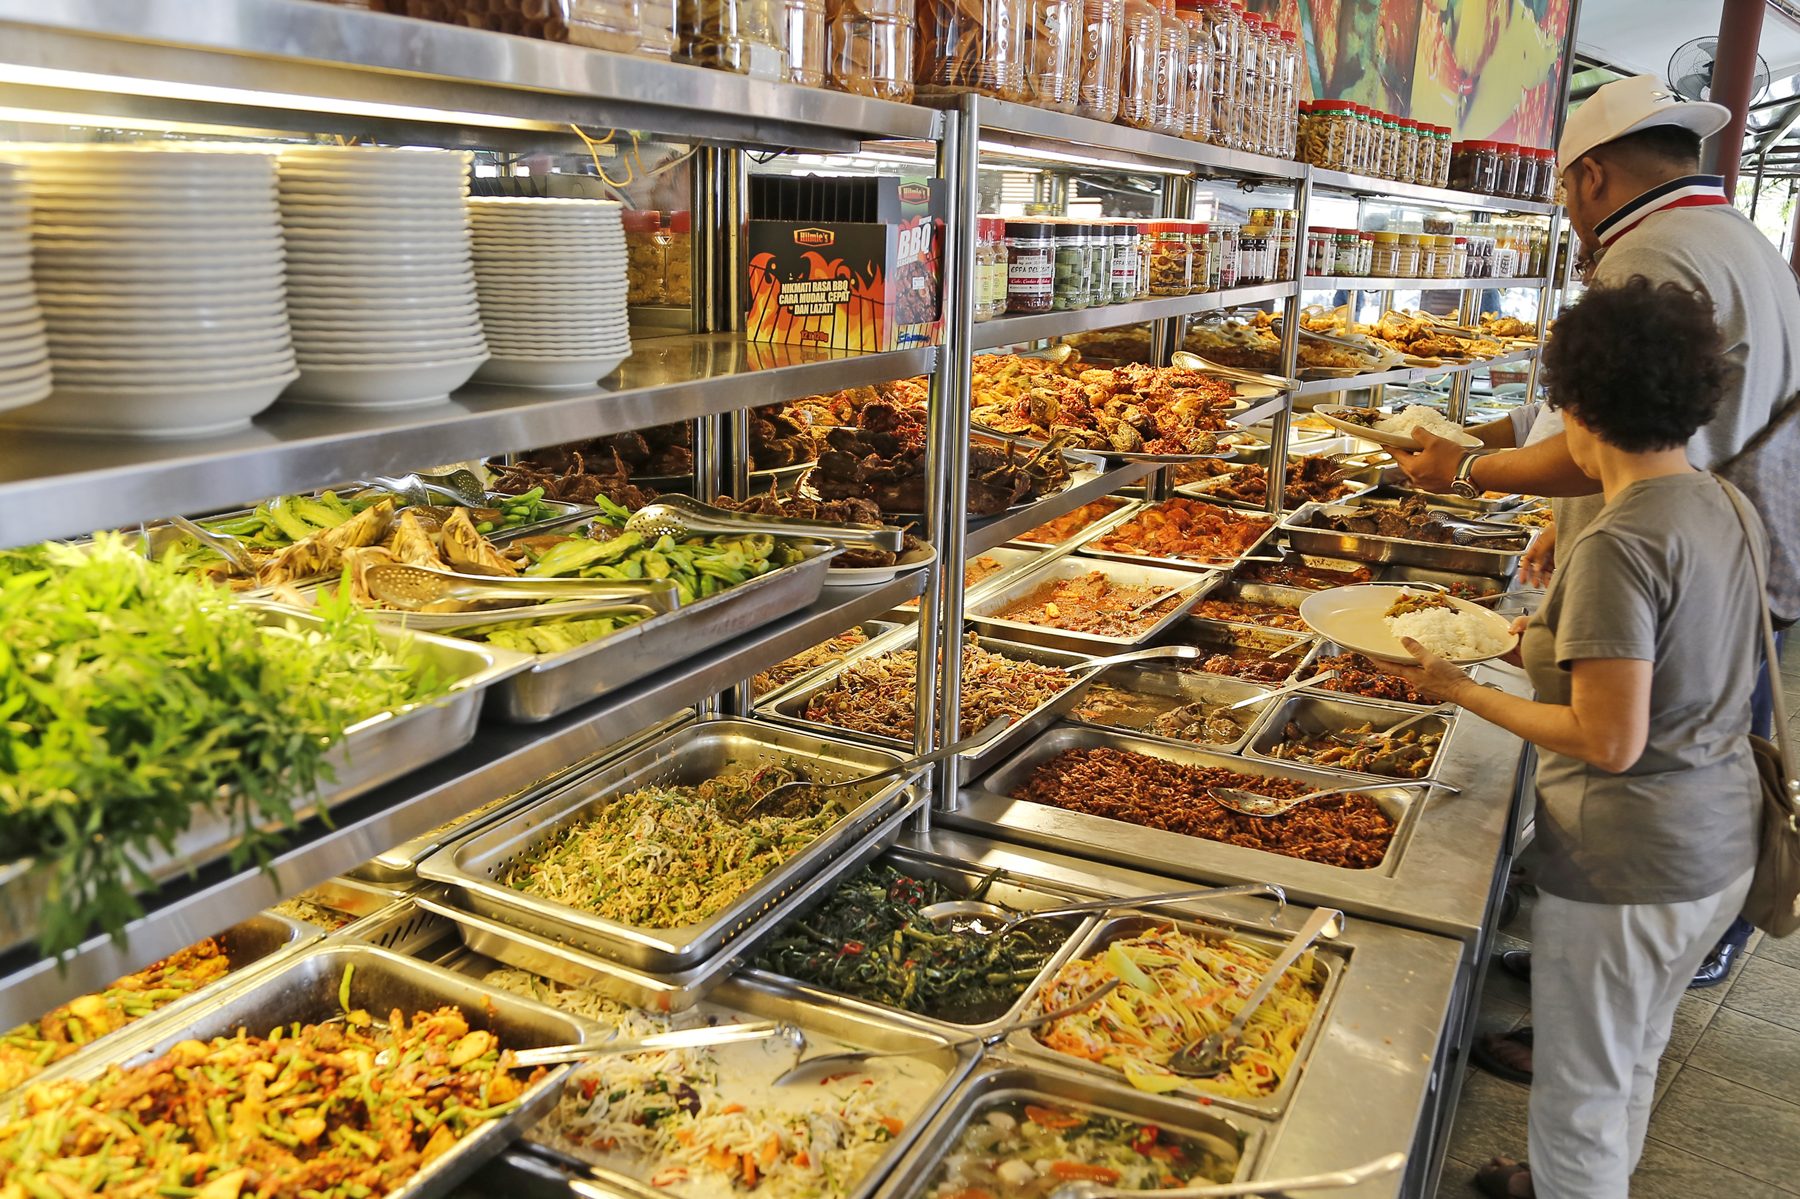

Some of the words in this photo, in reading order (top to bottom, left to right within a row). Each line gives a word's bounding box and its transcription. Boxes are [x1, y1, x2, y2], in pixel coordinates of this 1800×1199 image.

[800, 232, 829, 243] Hilmie's
[897, 222, 931, 260] BBQ
[781, 282, 811, 293] NIKMATI
[812, 281, 831, 292] RASA
[832, 280, 848, 291] BBQ
[779, 294, 798, 304] CARA
[828, 291, 850, 302] CEPAT
[794, 304, 809, 315] DAN
[810, 303, 833, 314] LAZAT!
